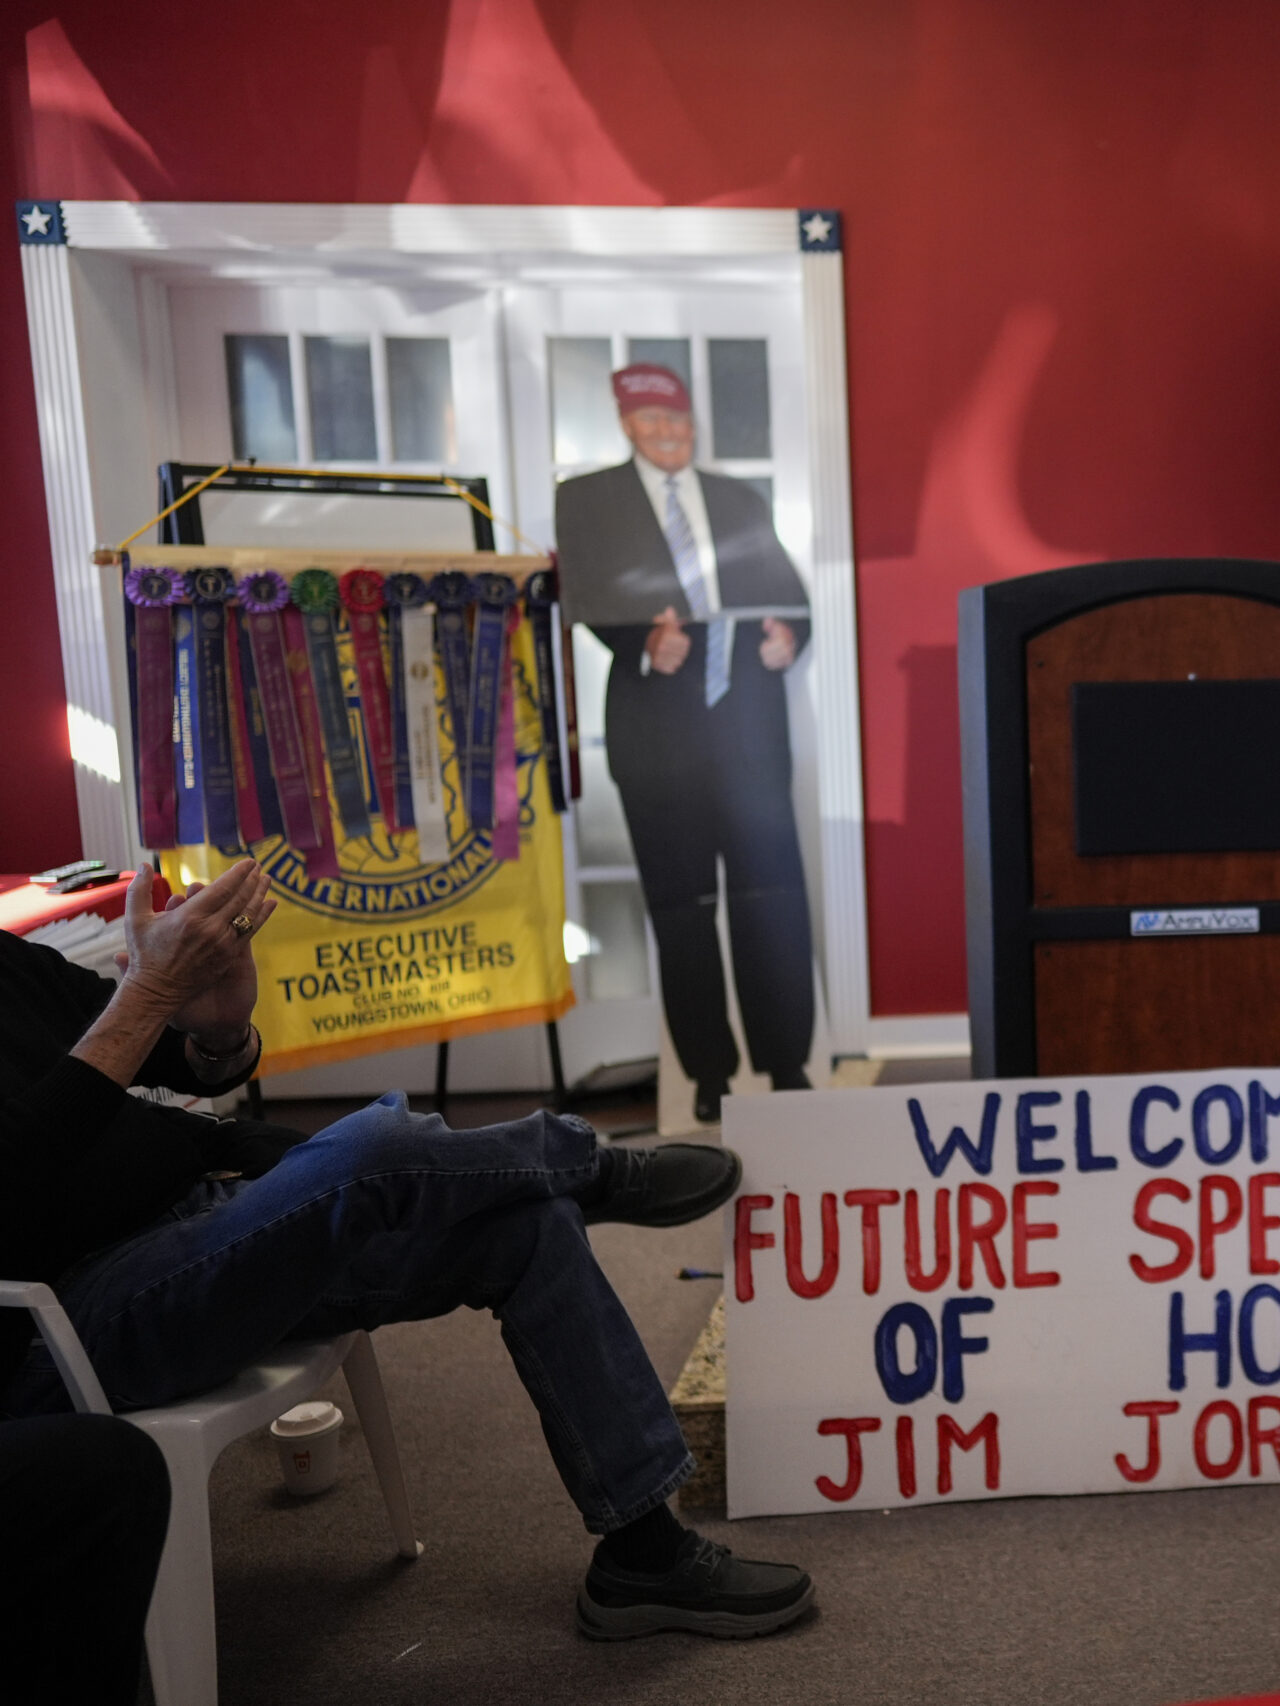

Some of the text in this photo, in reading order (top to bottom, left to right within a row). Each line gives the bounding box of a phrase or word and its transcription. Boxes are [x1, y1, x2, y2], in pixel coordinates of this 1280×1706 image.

[277, 943, 515, 1003] TOASTMASTERS
[315, 922, 477, 970] EXECUTIVE
[447, 985, 492, 1010] OHIO
[734, 1181, 1060, 1302] FUTURE
[874, 1297, 994, 1403] OF
[815, 1413, 1001, 1502] JIM
